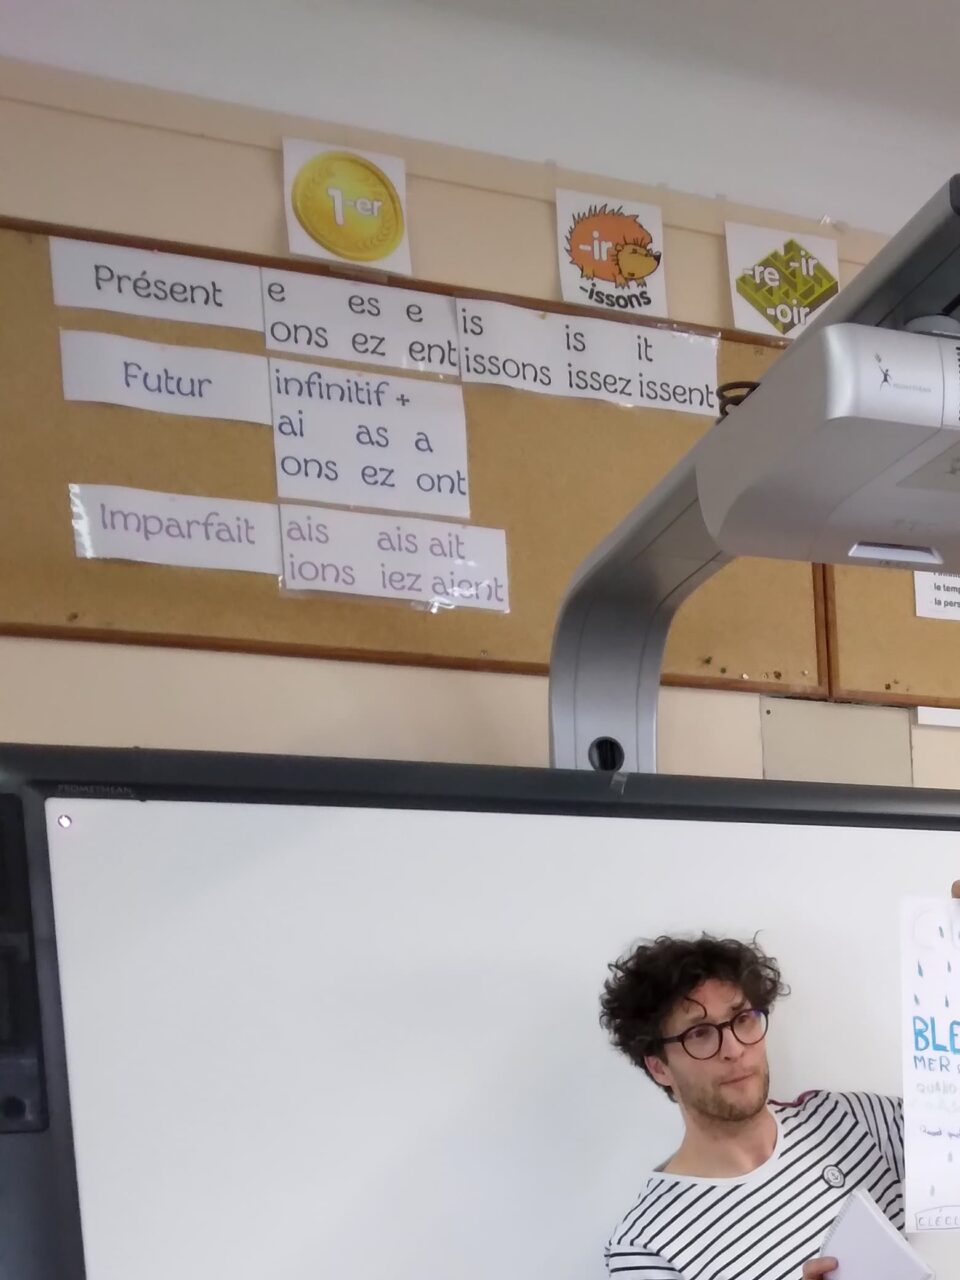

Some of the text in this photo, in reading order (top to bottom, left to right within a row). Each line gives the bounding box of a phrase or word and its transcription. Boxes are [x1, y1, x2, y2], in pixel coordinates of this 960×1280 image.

[579, 231, 612, 261] -ir
[790, 250, 817, 276] -ir
[93, 264, 224, 308] Présent
[744, 264, 780, 287] -re
[268, 281, 424, 324] e es e
[579, 282, 651, 310] -issons
[767, 299, 812, 325] -oir
[270, 320, 460, 368] ons ez ent
[462, 308, 653, 362] is is it
[123, 361, 212, 399] Futur
[275, 368, 389, 408] infinitif
[464, 347, 715, 408] issons issez issent
[278, 410, 434, 453] ai as a
[281, 454, 467, 497] ons ez ont
[99, 503, 257, 546] Imparfait
[286, 518, 466, 560] ais ais ait
[289, 558, 356, 586] ions
[381, 564, 423, 593] iez
[933, 582, 942, 592] le
[934, 597, 942, 607] la
[913, 1055, 951, 1073] MER
